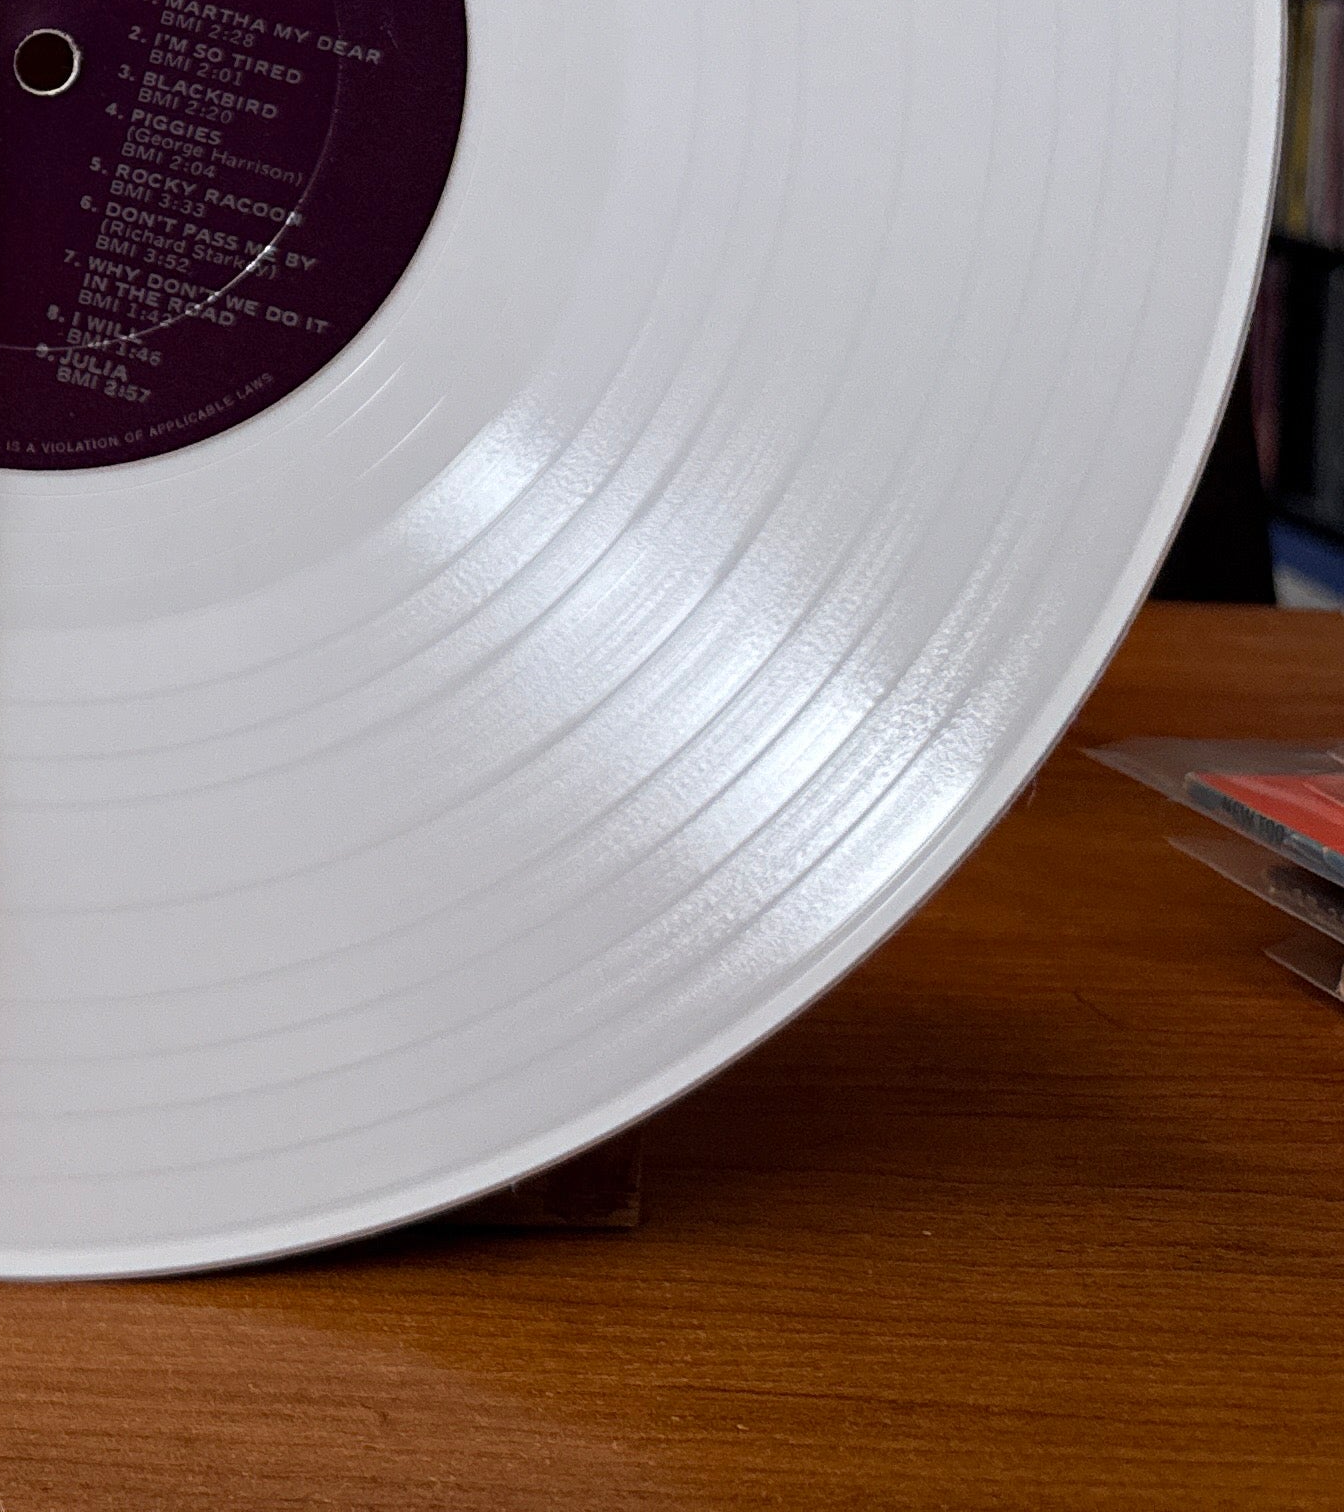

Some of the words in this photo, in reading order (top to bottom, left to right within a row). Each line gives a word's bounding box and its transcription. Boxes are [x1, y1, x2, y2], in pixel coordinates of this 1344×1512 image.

[160, 10, 202, 33] BMI
[208, 24, 255, 48] 2:28
[273, 23, 310, 44] MY
[316, 35, 382, 64] DEAR
[128, 25, 147, 43] 2.
[154, 32, 188, 53] I'M
[193, 42, 224, 63] SO
[232, 52, 302, 85] TIRED
[149, 49, 191, 71] BMI
[196, 62, 243, 87] 2:01
[118, 63, 135, 82] 3.
[142, 71, 278, 119] BLACKBIRD
[138, 87, 179, 110] BMI
[185, 100, 233, 124] 2:20
[105, 102, 124, 120] 4.
[131, 108, 223, 145] PIGGIES
[121, 141, 163, 165] BMI
[169, 155, 216, 179] 2:04
[126, 125, 205, 158] (George
[211, 148, 304, 187] Harrison)
[89, 156, 108, 175] 5.
[115, 163, 198, 196] ROCKY
[204, 188, 304, 228] RACOON
[110, 180, 152, 203] BMI
[158, 193, 206, 218] 3:33
[79, 195, 97, 213] 6.
[105, 201, 179, 234] DON'T
[182, 222, 240, 252] PASS
[244, 239, 278, 263] ME
[285, 251, 317, 271] BY
[100, 217, 187, 255] (Richard
[95, 235, 137, 258] BMI
[143, 248, 190, 274] 3:52
[63, 248, 81, 268] 7.
[88, 255, 141, 282] WHY
[225, 294, 260, 317] WE
[264, 304, 300, 327] DO
[305, 316, 330, 335] IT
[78, 288, 120, 313] BMI
[82, 272, 109, 291] IN
[115, 281, 161, 308] THE
[167, 296, 236, 327] ROAD
[46, 303, 65, 323] 8.
[72, 311, 81, 327] I
[86, 314, 143, 345] WILL
[59, 348, 129, 383] JULIA
[66, 327, 110, 351] BMI
[115, 341, 162, 367] 1:46
[56, 365, 99, 389] BMI
[104, 378, 152, 404] 2:57
[6, 440, 21, 452] IS
[26, 442, 36, 454] A
[40, 436, 119, 454] VIOLATION
[124, 429, 144, 444] OF
[149, 394, 234, 438] APPLICABLE
[236, 372, 274, 400] LAWS
